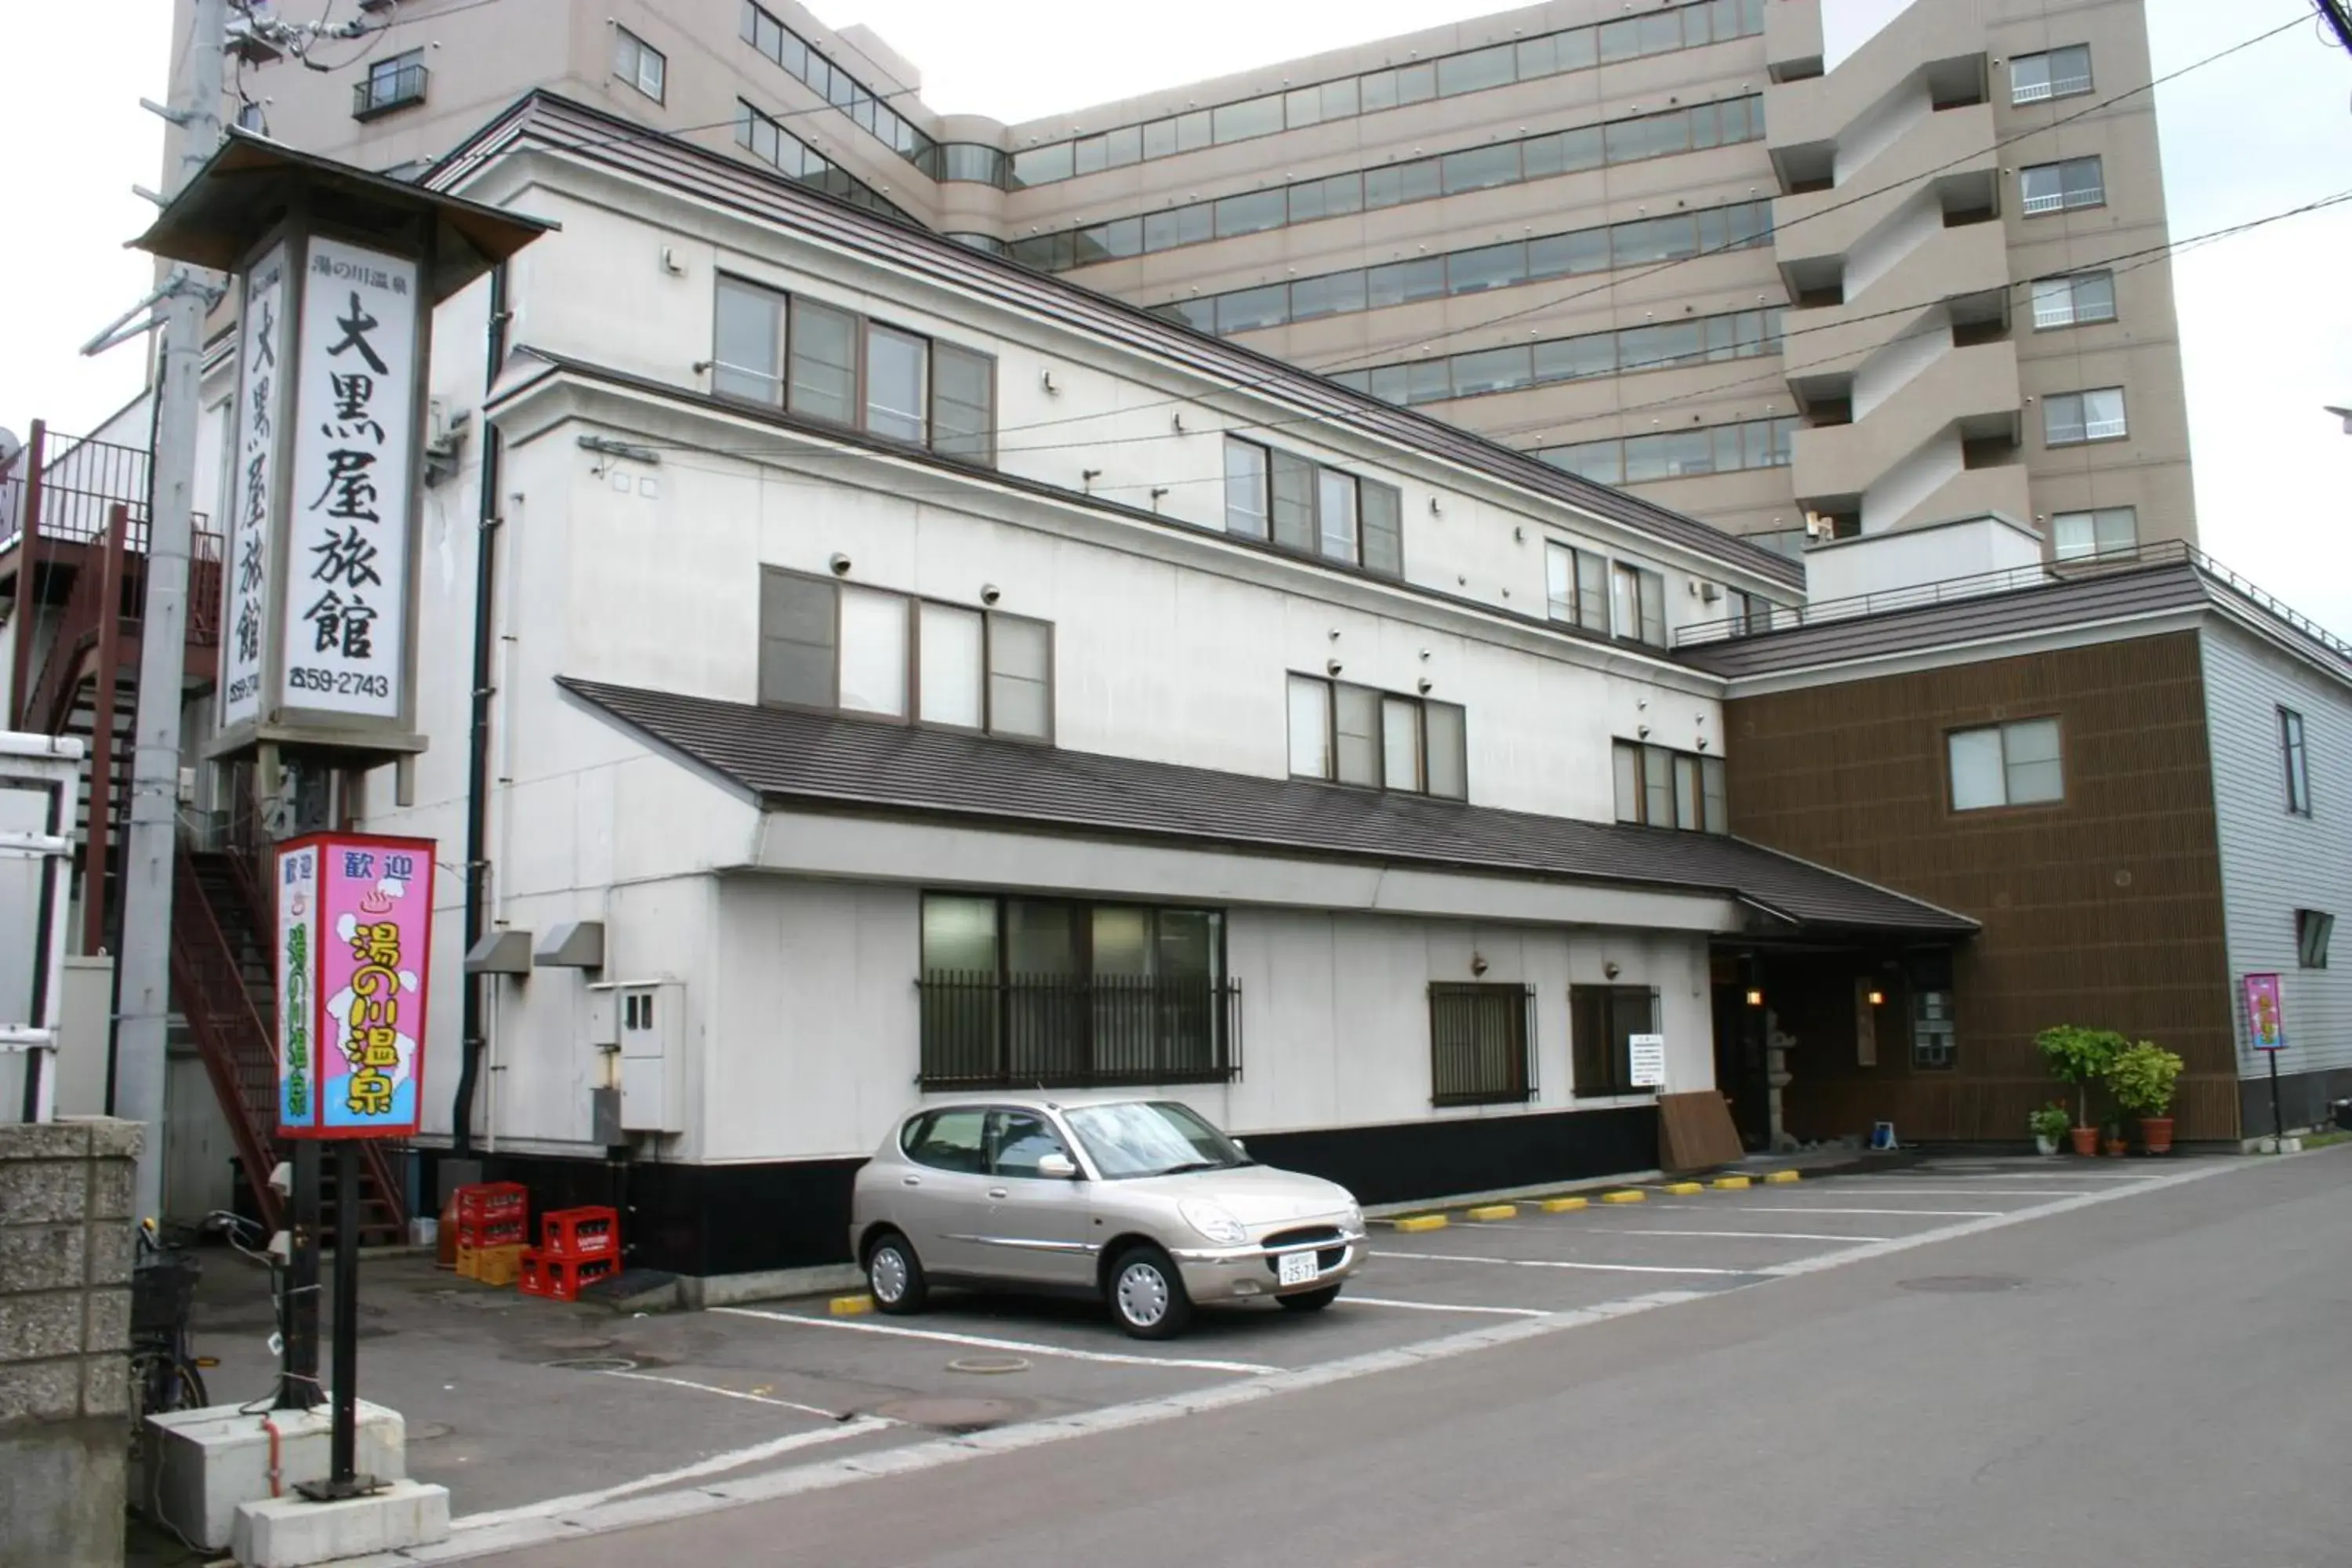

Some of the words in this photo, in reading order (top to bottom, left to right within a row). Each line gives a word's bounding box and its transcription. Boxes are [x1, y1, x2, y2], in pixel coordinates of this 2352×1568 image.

[310, 254, 408, 296] 湯の川温泉
[236, 299, 276, 665] 大黒屋旅館
[303, 290, 388, 661] 大黒屋旅館
[344, 851, 412, 880] 歓迎
[346, 921, 401, 1116] 湯の川温泉
